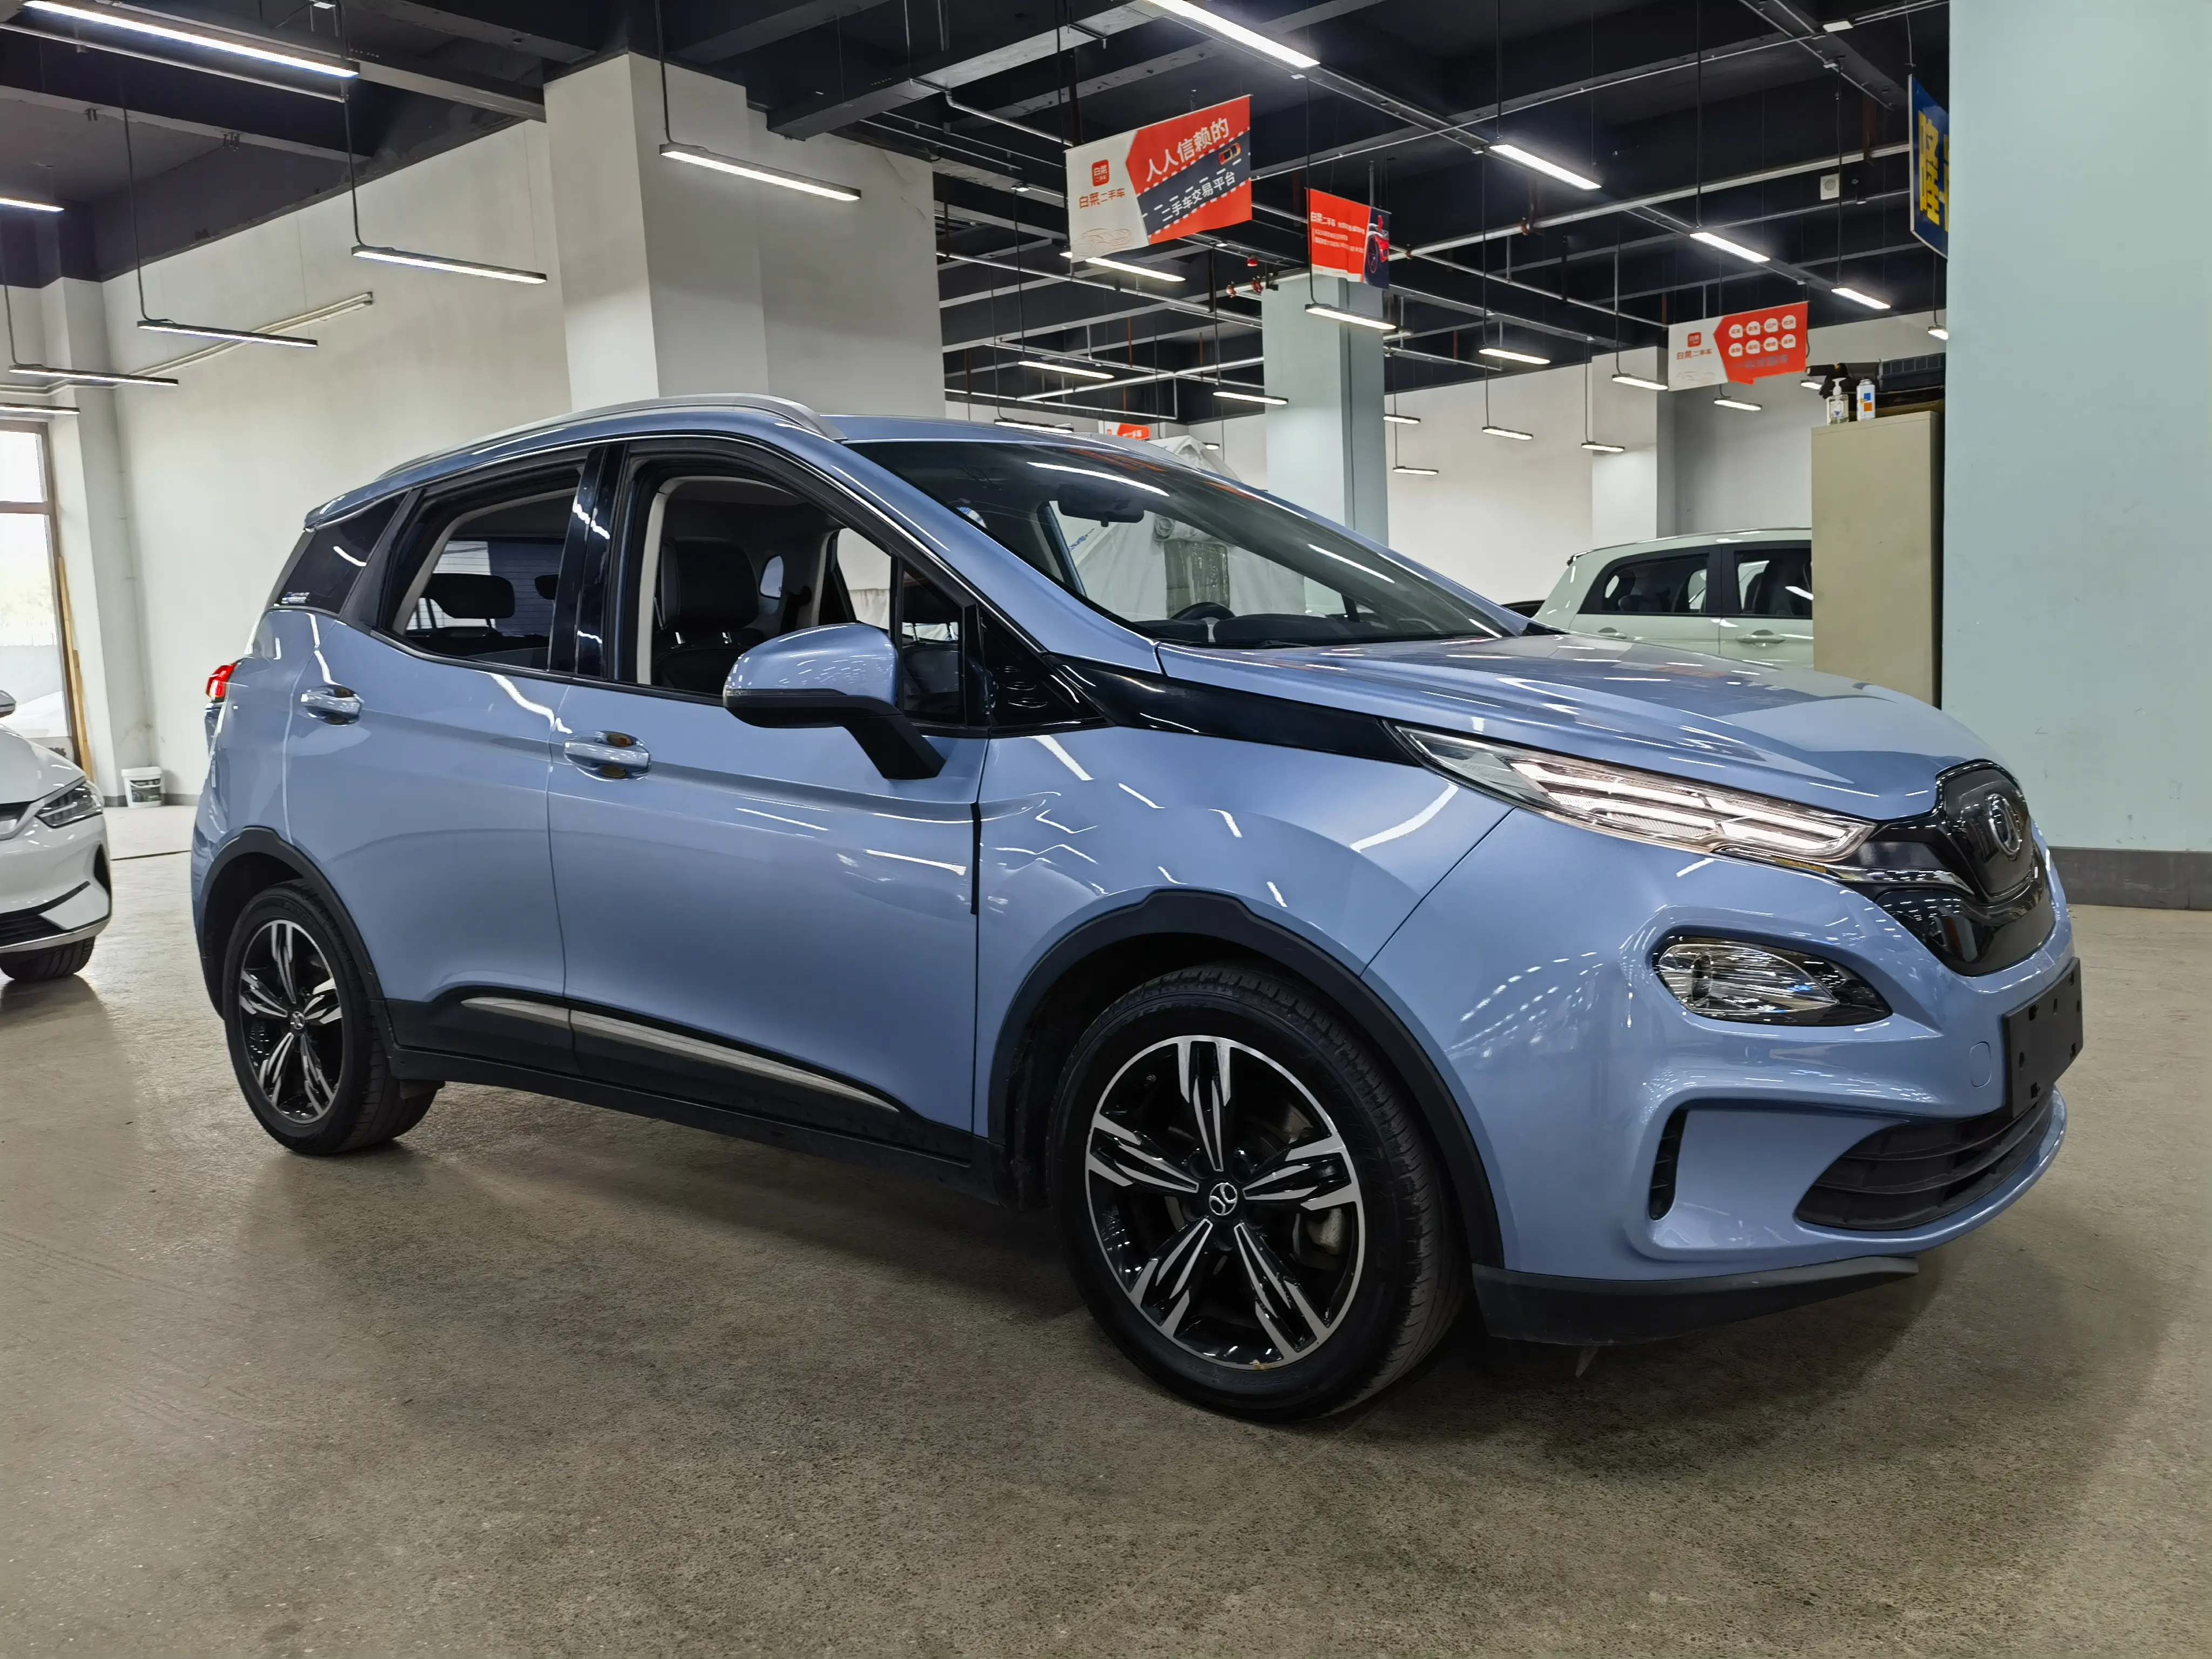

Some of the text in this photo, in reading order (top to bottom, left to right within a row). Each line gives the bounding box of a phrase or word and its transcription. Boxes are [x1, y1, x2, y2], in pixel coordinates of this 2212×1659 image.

[1145, 117, 1229, 182] 人人信赖的
[1161, 171, 1236, 222] 二手车交易平台
